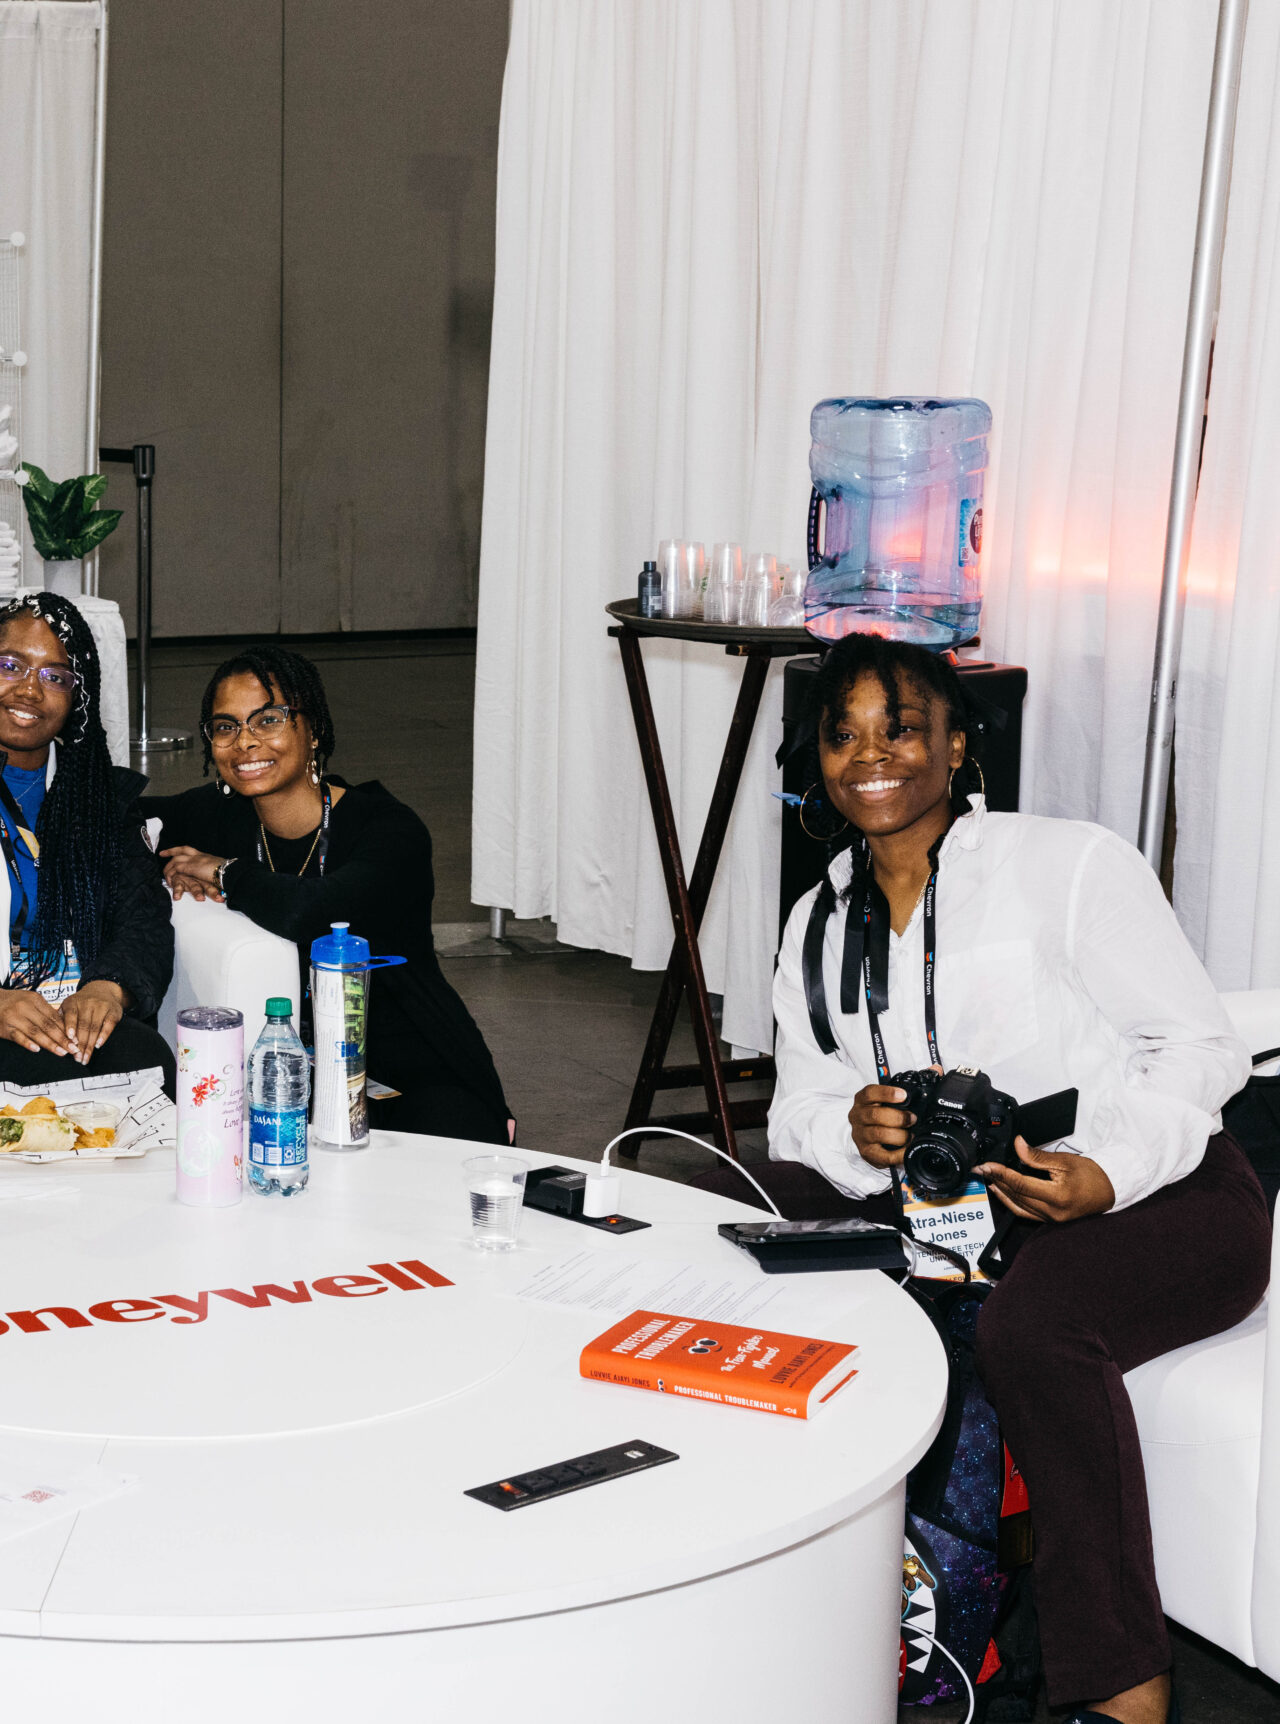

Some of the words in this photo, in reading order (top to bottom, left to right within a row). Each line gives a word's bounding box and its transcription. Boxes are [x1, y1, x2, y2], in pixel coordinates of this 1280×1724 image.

[323, 804, 331, 829] Chevron
[926, 886, 934, 917] Chevron
[874, 1033, 884, 1065] Chevron
[930, 1043, 938, 1065] Chev
[938, 1098, 963, 1110] Canon
[253, 1114, 282, 1126] DASANI
[909, 1210, 985, 1230] Atra-Niese
[928, 1229, 968, 1244] Jones
[964, 1241, 985, 1251] TECH
[612, 1318, 671, 1355] PROFESSIONAL
[634, 1321, 697, 1360] TROUBLEMAKER
[768, 1366, 798, 1385] LUVVIE
[787, 1354, 811, 1368] AJAYI
[801, 1342, 825, 1357] JONES
[589, 1369, 612, 1382] LUVVIE
[612, 1373, 631, 1385] AJAYI
[631, 1377, 651, 1389] JONES
[673, 1384, 723, 1402] PROFESSIONAL
[724, 1395, 778, 1412] TROUBLEMAKER
